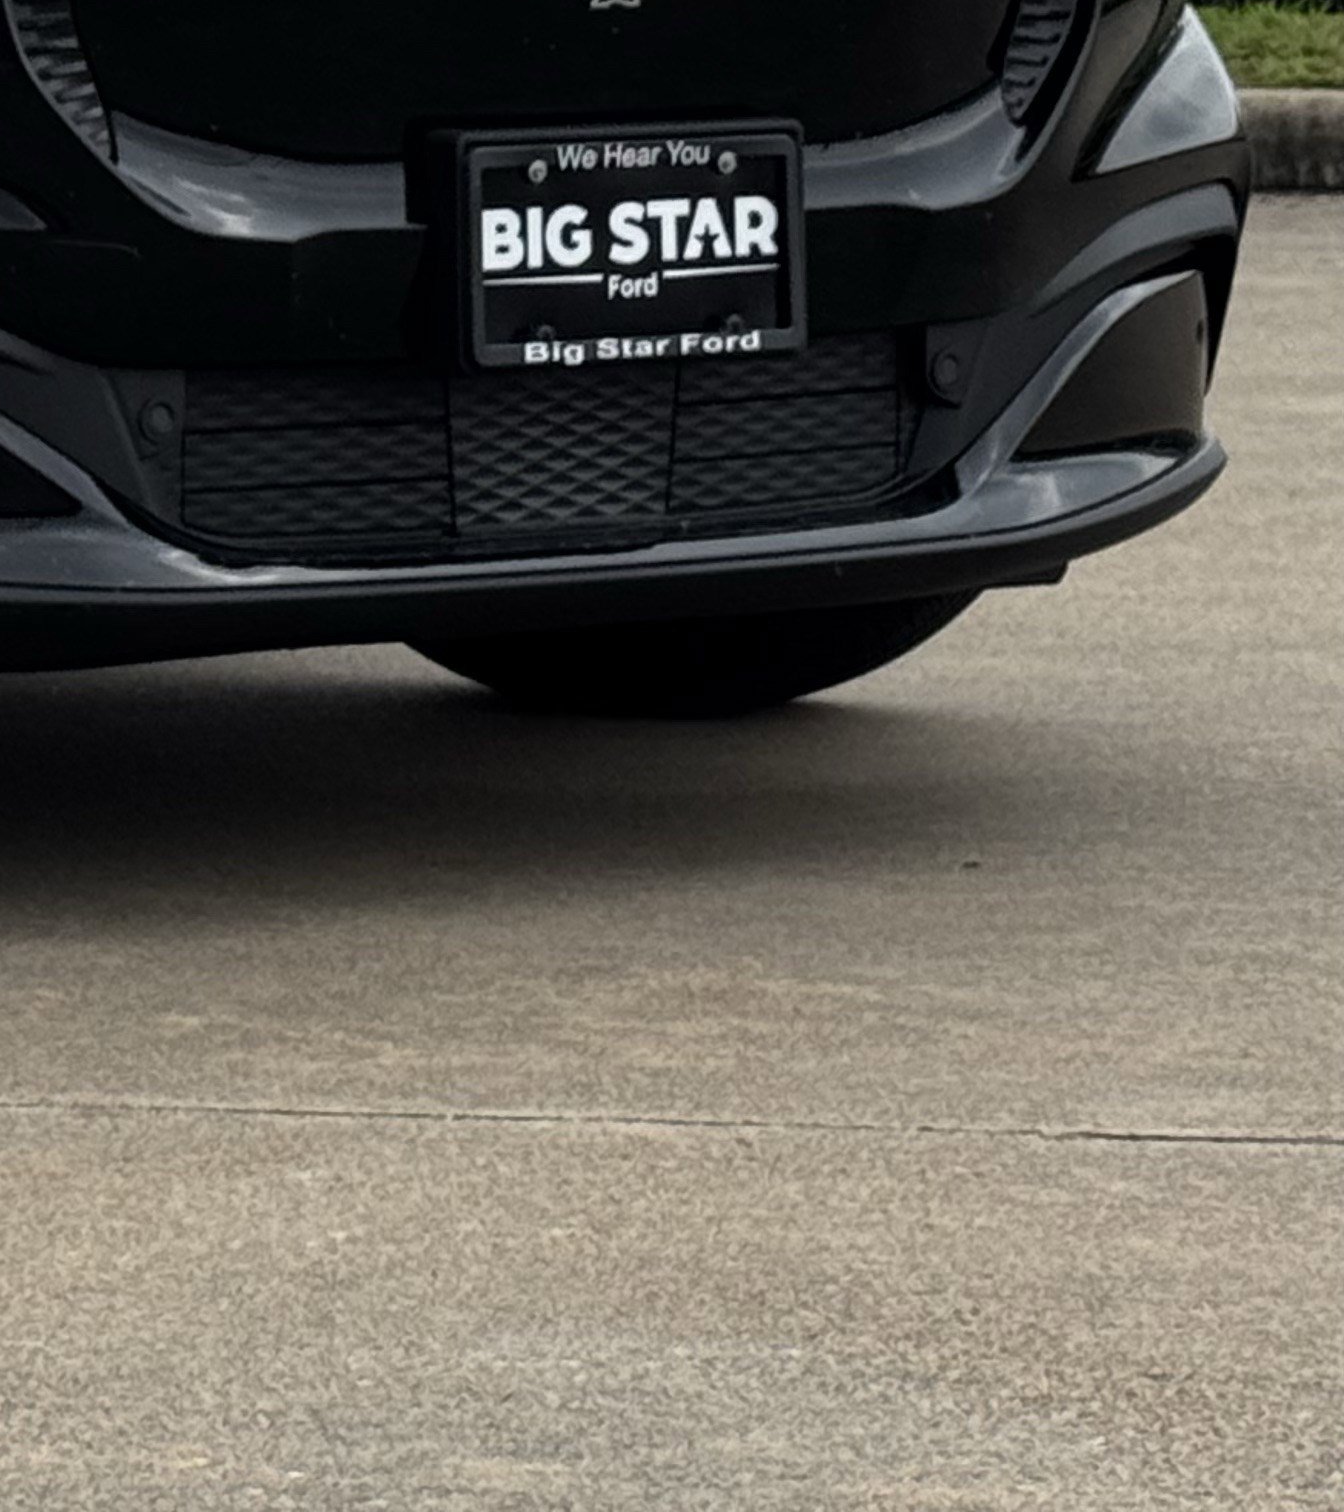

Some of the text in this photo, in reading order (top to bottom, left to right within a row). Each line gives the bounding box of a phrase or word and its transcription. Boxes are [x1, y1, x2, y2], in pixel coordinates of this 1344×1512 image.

[557, 140, 710, 170] We Hear You
[481, 195, 779, 271] BIG STAR
[607, 273, 659, 300] Ford
[524, 329, 761, 366] Big Star Ford
